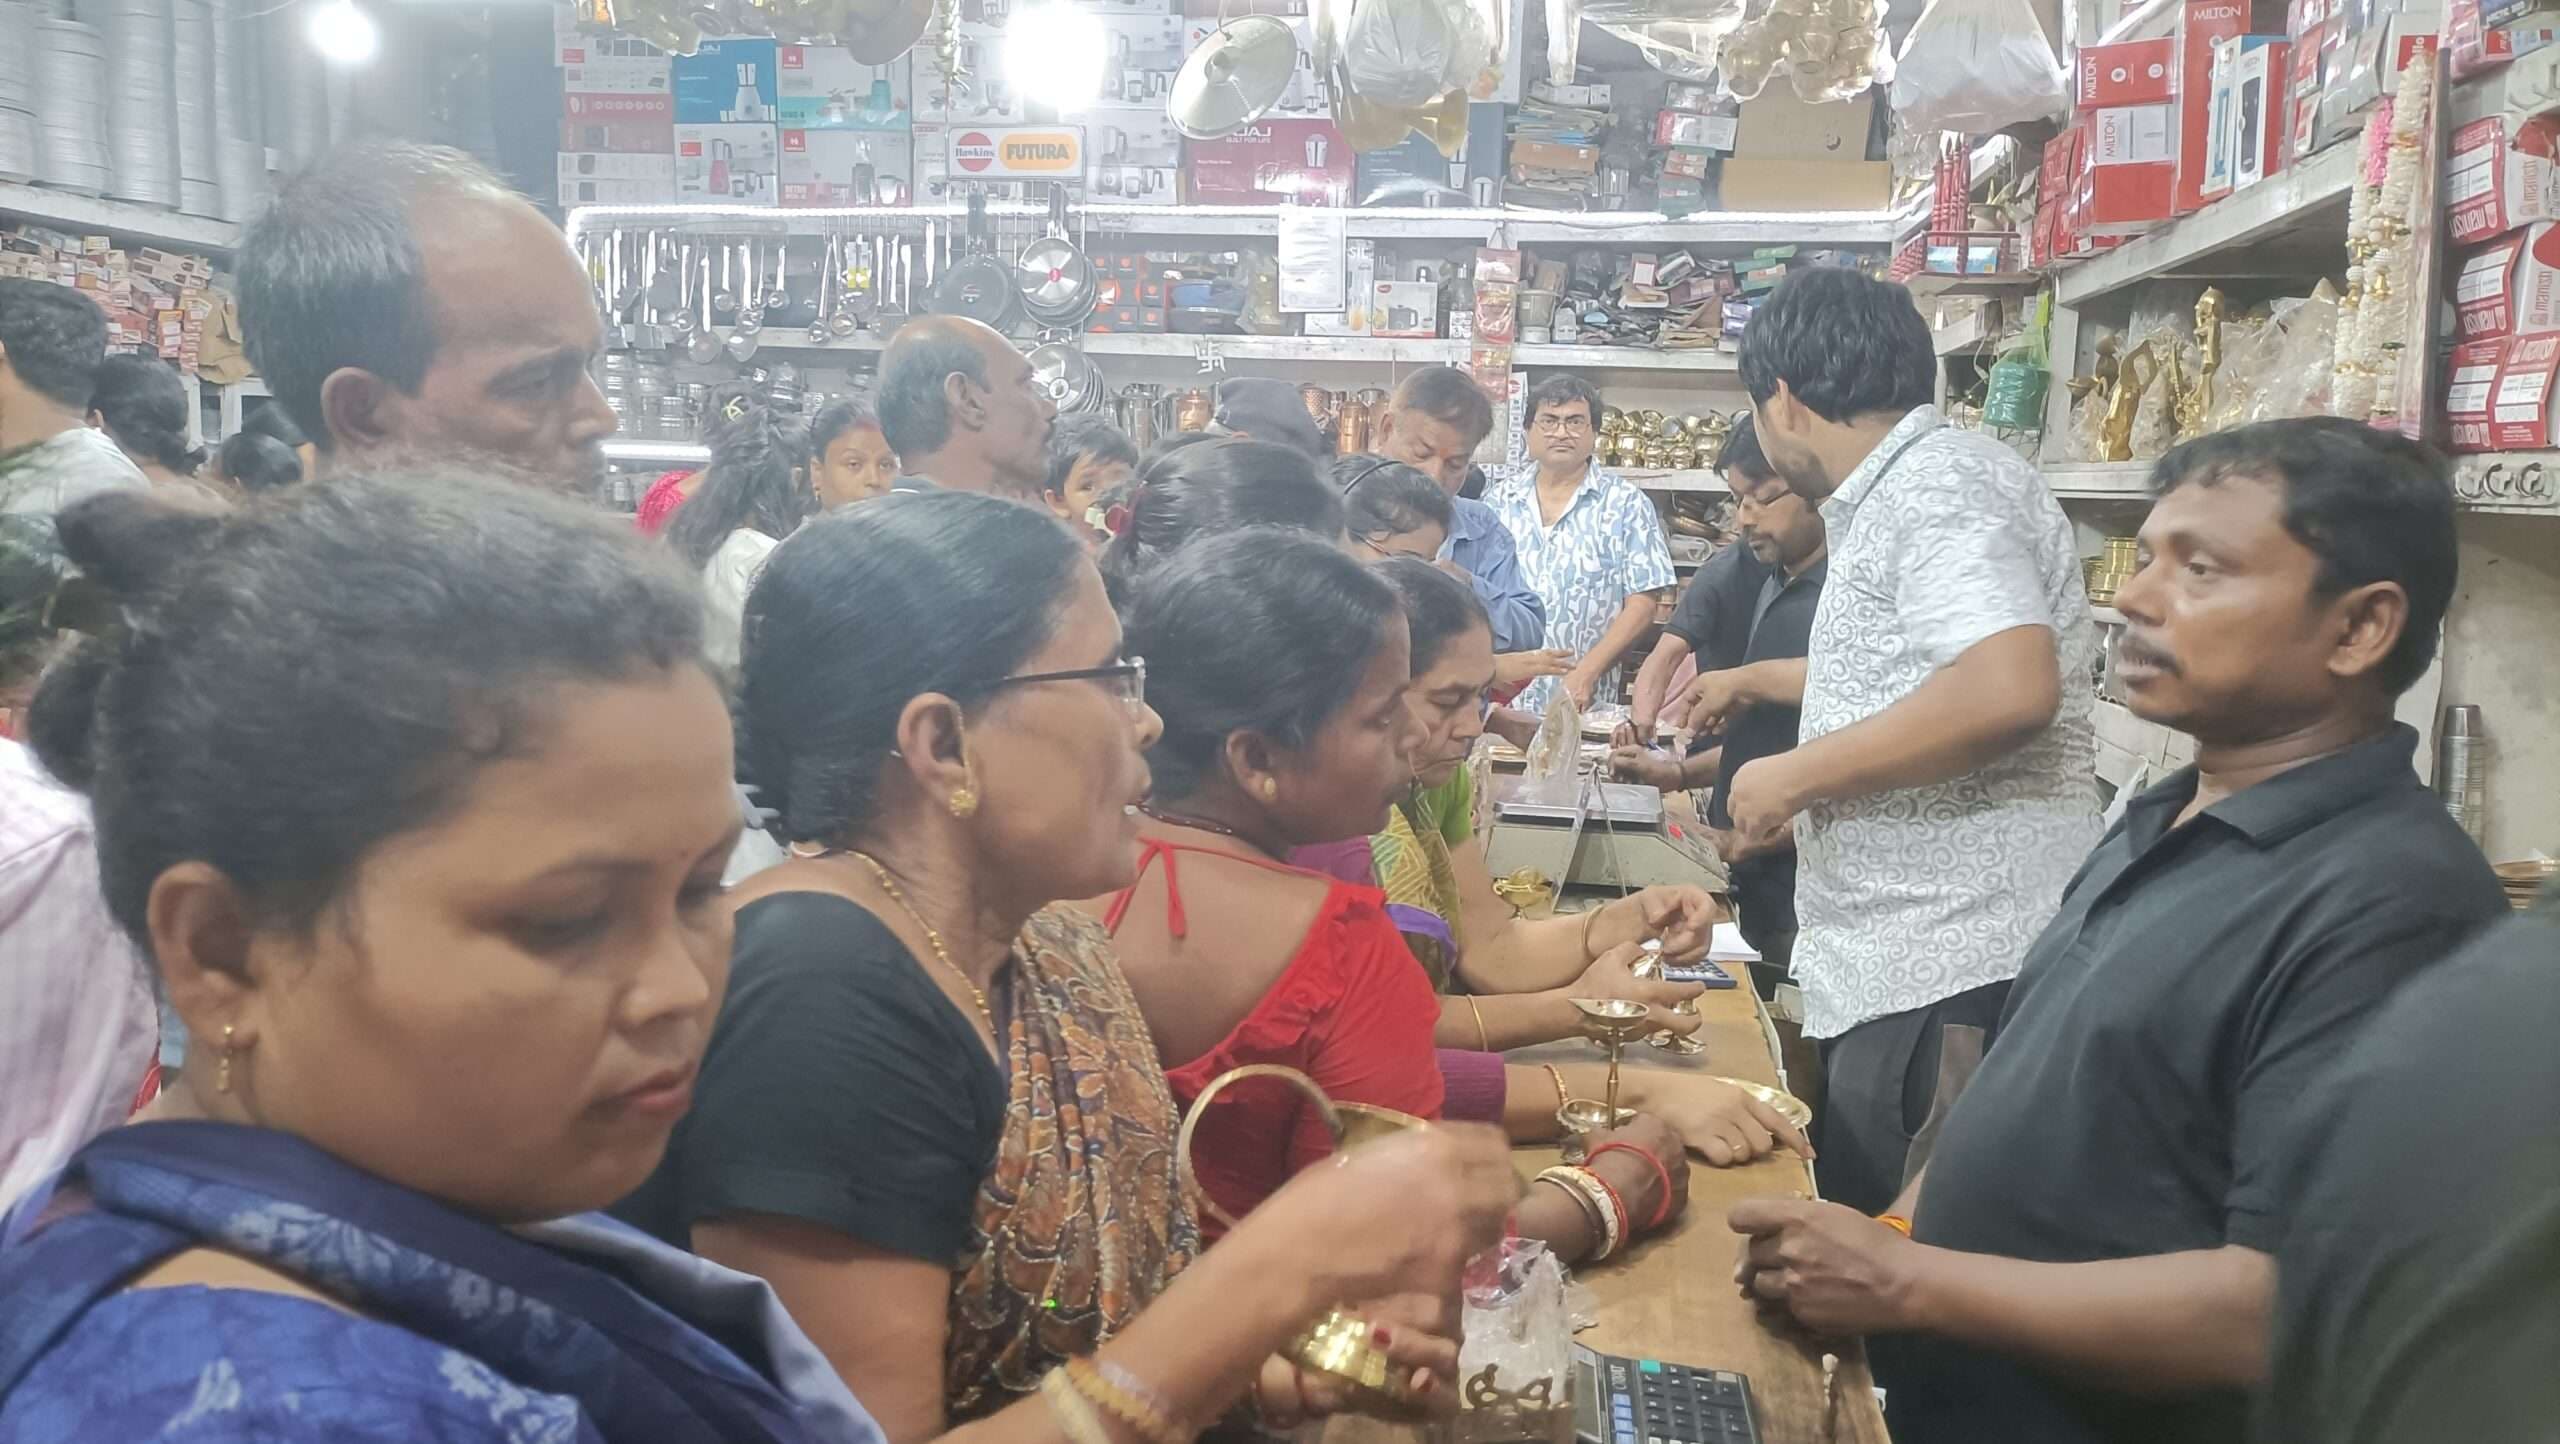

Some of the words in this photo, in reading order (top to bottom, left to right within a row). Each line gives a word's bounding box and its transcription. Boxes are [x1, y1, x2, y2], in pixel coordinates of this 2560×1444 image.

[2193, 6, 2242, 21] MILTON
[2086, 56, 2097, 99] MILTON
[955, 146, 995, 159] Hawkins
[1006, 142, 1070, 160] FUTURA
[2105, 115, 2116, 157] MILTON
[2535, 270, 2553, 312] manish
